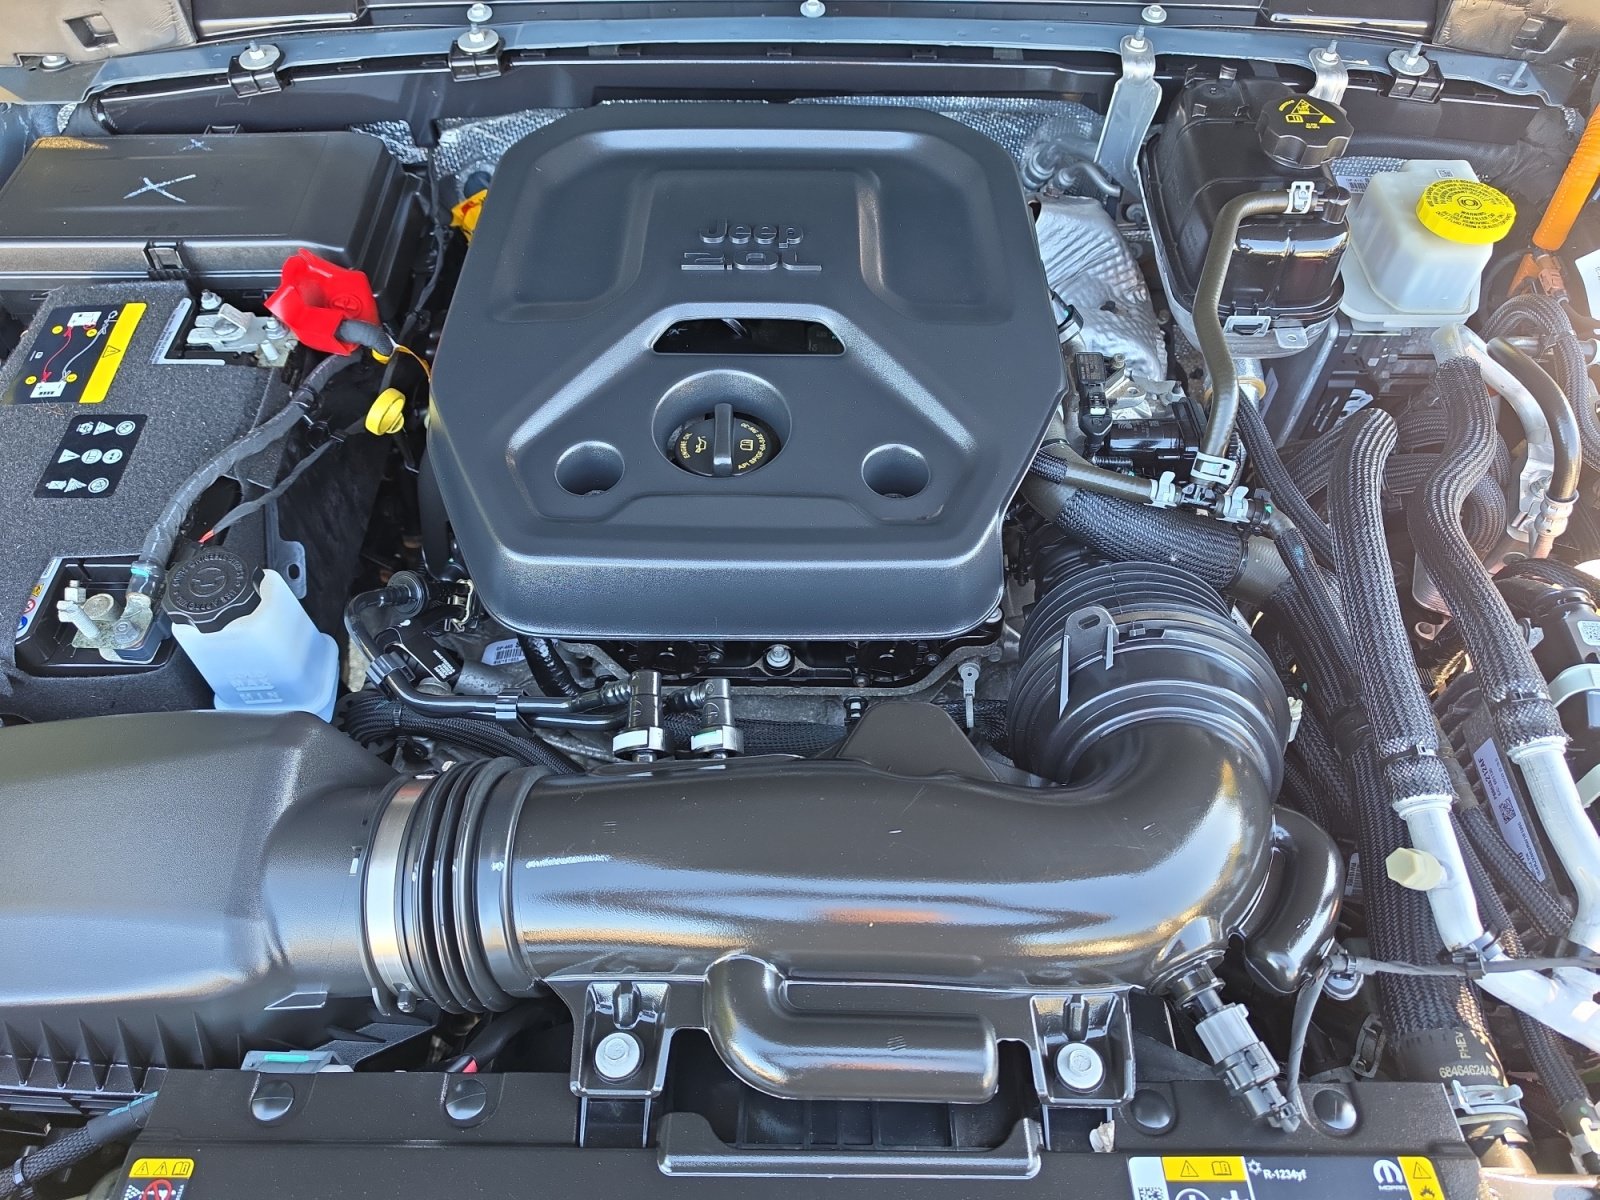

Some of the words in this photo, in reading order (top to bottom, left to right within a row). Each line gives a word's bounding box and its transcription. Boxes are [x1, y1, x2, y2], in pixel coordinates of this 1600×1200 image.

[700, 218, 804, 249] Jeep
[681, 250, 823, 271] 2.0L
[1455, 1031, 1472, 1059] PHEV
[1262, 1168, 1307, 1182] R-1234yf
